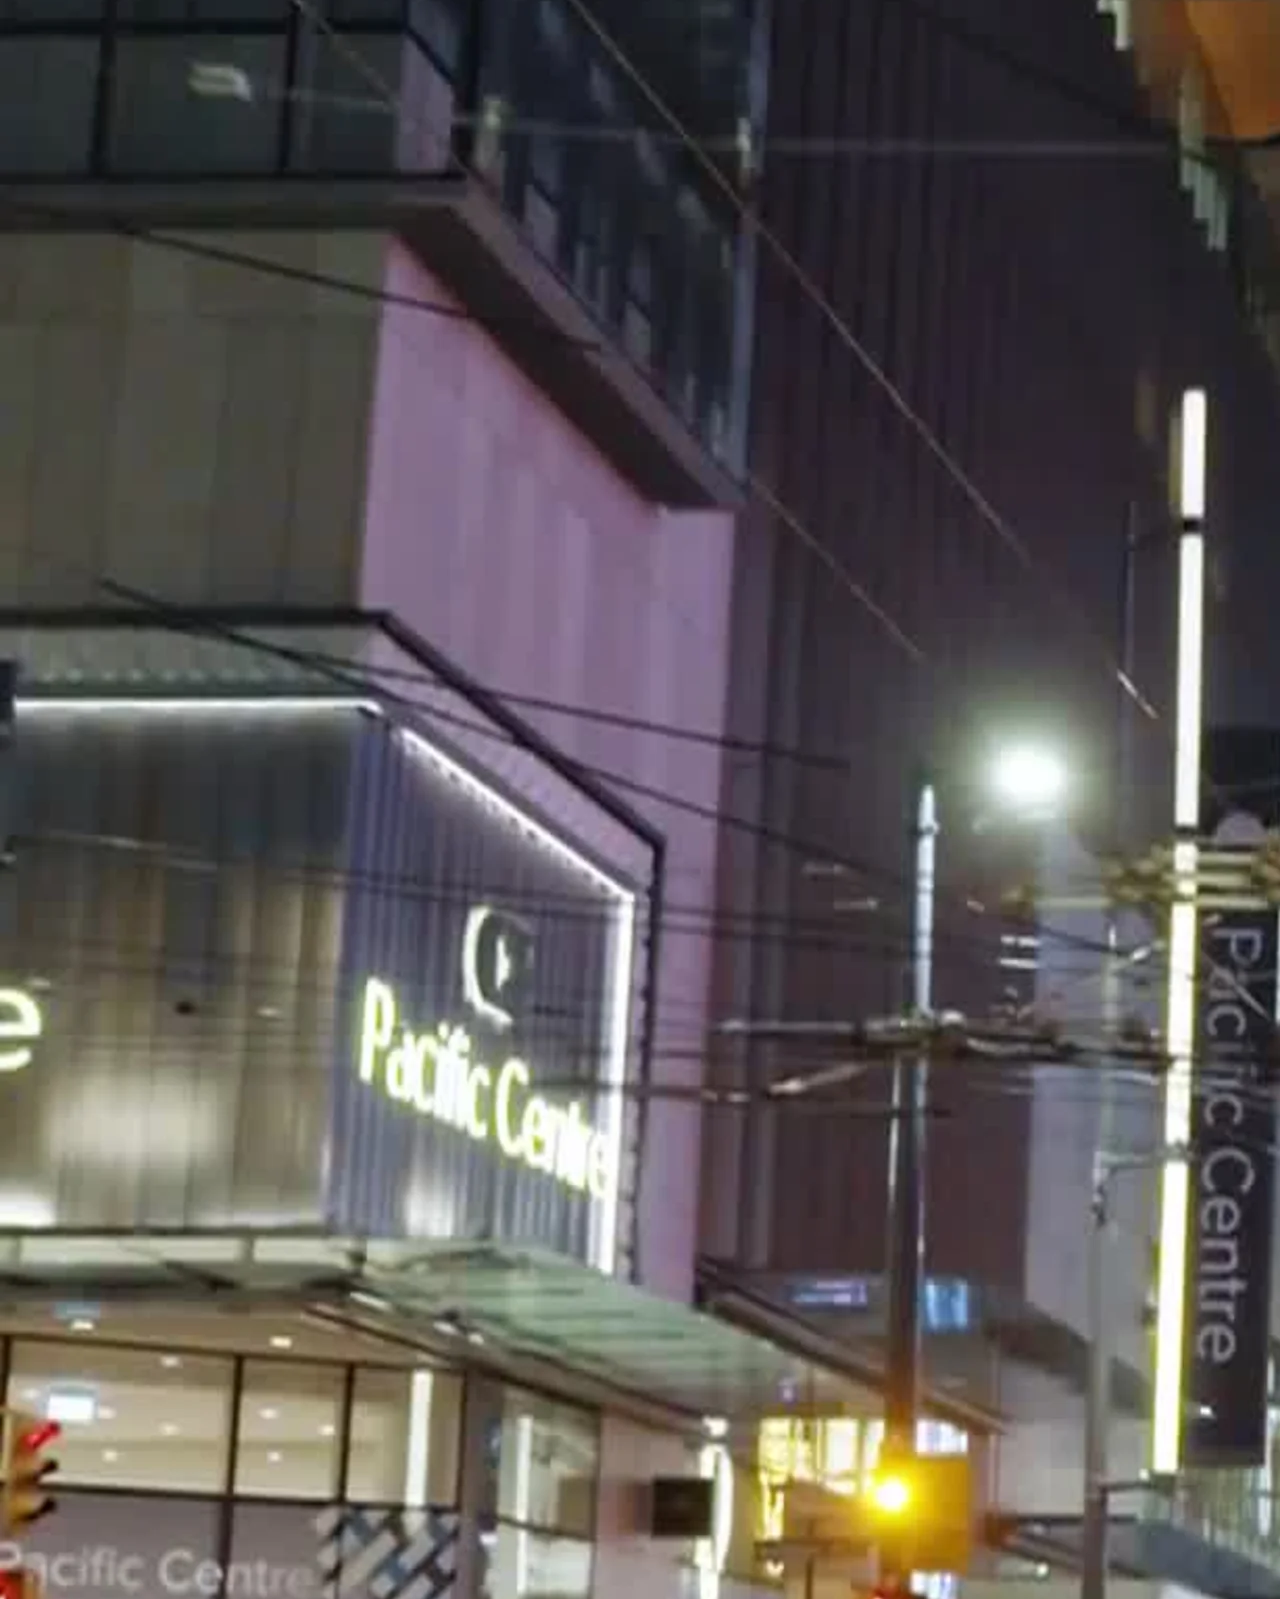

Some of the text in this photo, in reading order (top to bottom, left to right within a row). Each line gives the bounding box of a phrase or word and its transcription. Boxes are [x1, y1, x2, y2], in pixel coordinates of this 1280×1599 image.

[357, 976, 614, 1200] Pacific Centre
[1197, 1148, 1255, 1363] Centre
[156, 1548, 317, 1599] Centre
